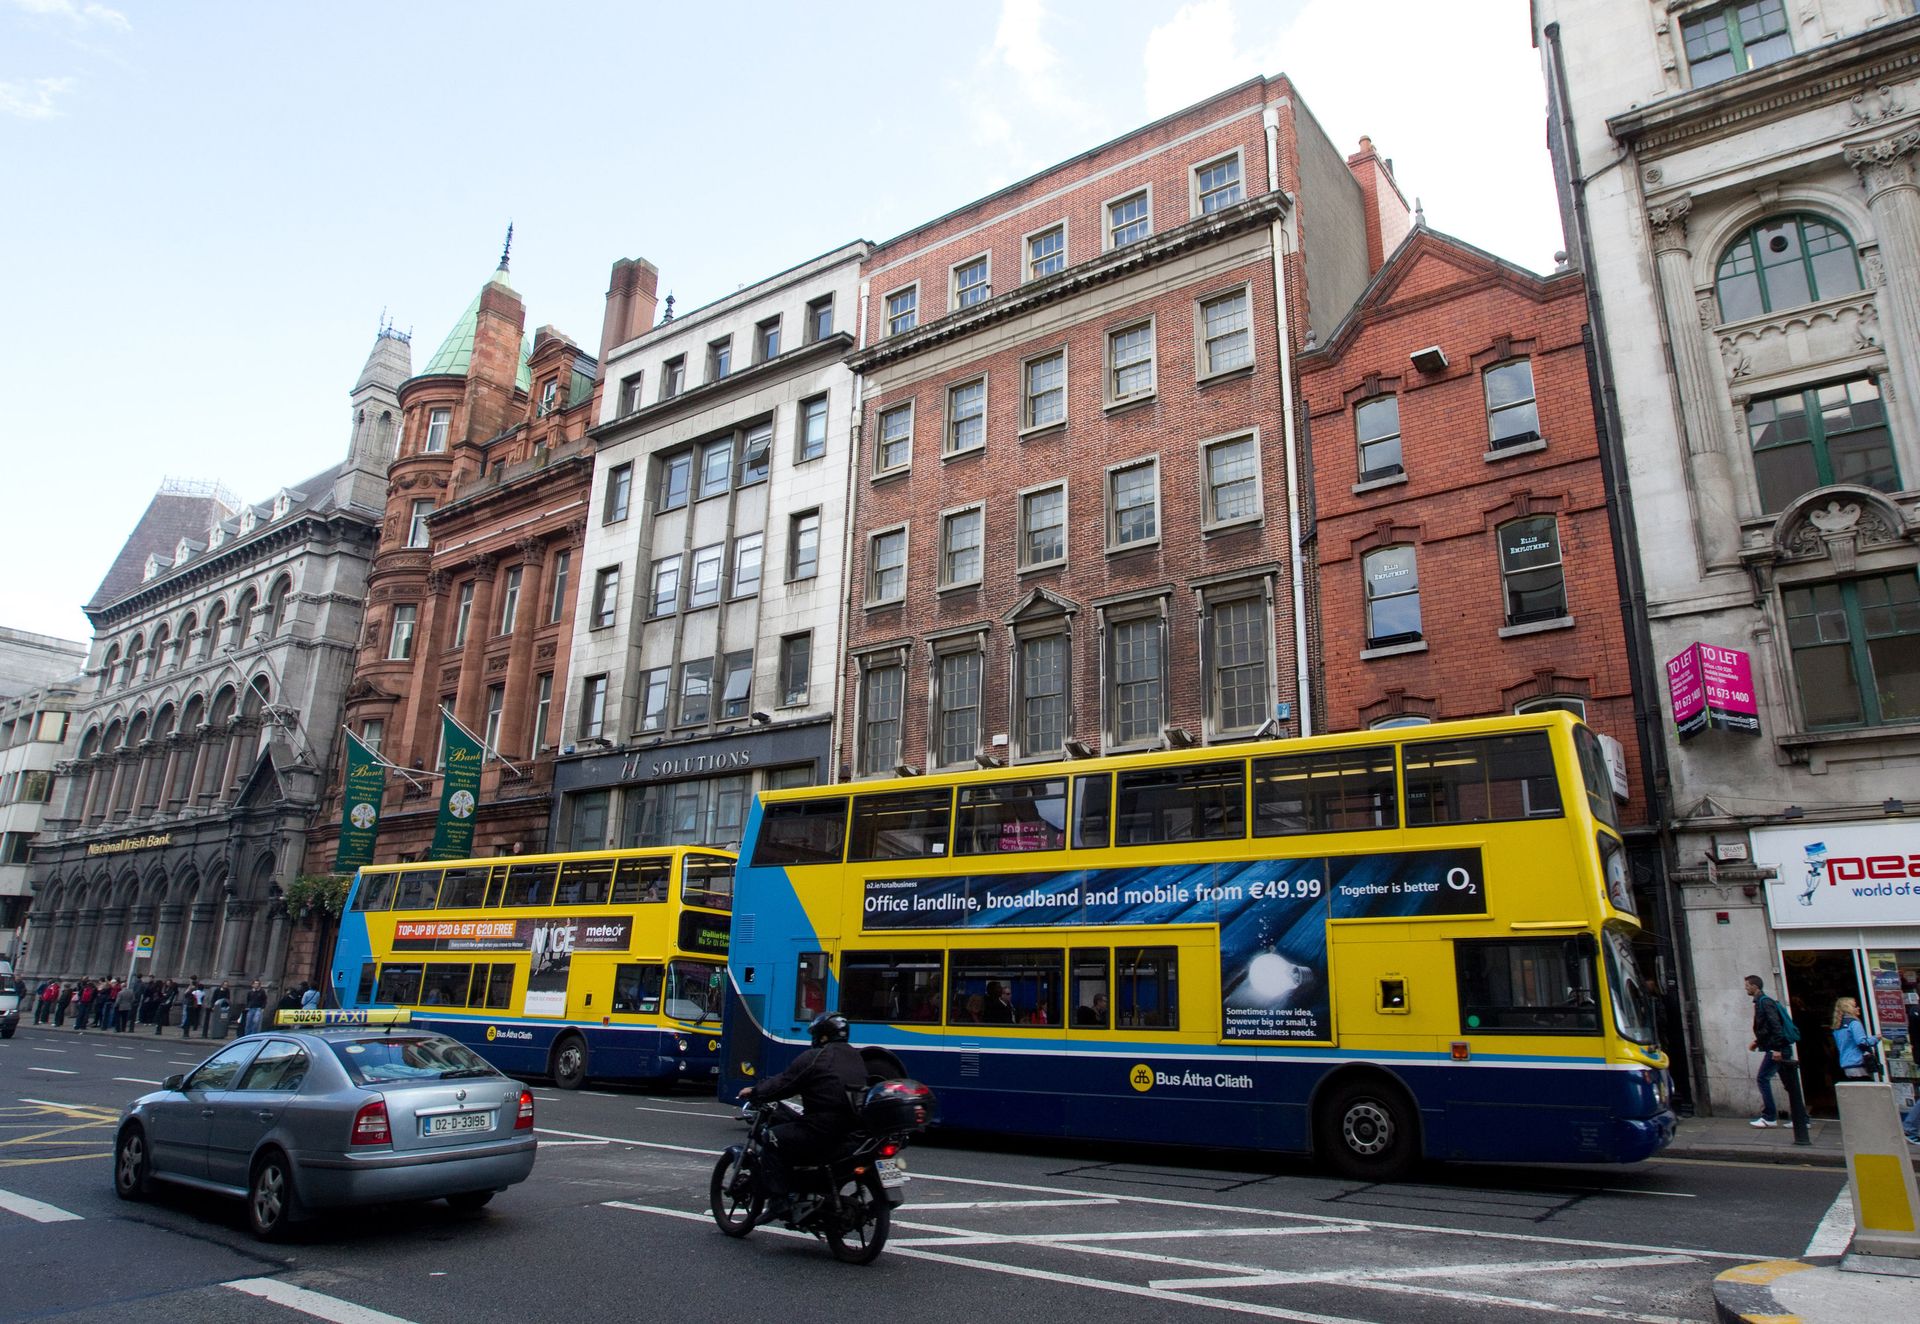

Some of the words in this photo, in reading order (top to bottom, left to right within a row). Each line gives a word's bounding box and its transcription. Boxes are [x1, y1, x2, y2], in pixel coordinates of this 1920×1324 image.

[1510, 542, 1549, 554] EMPLOYMENT
[1668, 660, 1680, 676] TO
[1680, 650, 1692, 669] LET
[1701, 646, 1716, 660] TO
[1719, 650, 1737, 666] LET
[1674, 700, 1682, 711] 01
[1682, 694, 1692, 708] 673
[1691, 687, 1701, 702] 1400
[1707, 685, 1715, 696] 01
[1717, 688, 1730, 699] 673
[1731, 690, 1750, 703] 1400
[449, 747, 481, 761] Bank
[652, 750, 750, 776] SOLUTIONS
[351, 764, 384, 777] Bank
[87, 839, 124, 855] National
[125, 837, 146, 850] Irish
[147, 833, 170, 847] Bank
[866, 881, 918, 889] o2.ie/totalbusiness
[1339, 884, 1389, 898] Together
[1392, 882, 1401, 893] is
[1404, 881, 1440, 893] better
[1852, 882, 1893, 897] world
[1895, 882, 1910, 895] of
[865, 895, 908, 912] Office
[913, 893, 981, 912] landline,
[986, 888, 1079, 909] broadband
[1085, 887, 1119, 905] and
[1124, 885, 1189, 903] mobile
[1195, 883, 1243, 902] from
[1248, 879, 1321, 899] €49.99
[398, 924, 425, 936] TOP-UP
[426, 924, 437, 935] BY
[437, 924, 452, 935] €20
[453, 924, 461, 935] &
[461, 924, 476, 935] GET
[476, 923, 492, 935] €20
[493, 923, 513, 935] FREE
[586, 924, 626, 936] meteor
[293, 1010, 322, 1022] 30243
[330, 1009, 365, 1023] TAXI
[1226, 1008, 1267, 1016] Sometimes
[1294, 1008, 1313, 1017] idea,
[1882, 1010, 1903, 1019] Sale
[1226, 1017, 1260, 1025] however
[1261, 1018, 1274, 1027] big
[1286, 1019, 1309, 1027] small,
[1310, 1019, 1317, 1027] is
[497, 1030, 507, 1038] Bus
[506, 1028, 518, 1038] Átha
[518, 1031, 533, 1039] Cliath
[1226, 1027, 1236, 1035] all
[1237, 1028, 1255, 1037] your
[1257, 1028, 1289, 1036] business
[1291, 1029, 1316, 1037] needs.
[1156, 1072, 1180, 1086] Bus
[1182, 1070, 1212, 1087] Átha
[1214, 1073, 1253, 1088] Cliath
[435, 1115, 486, 1130] 02-D-33196
